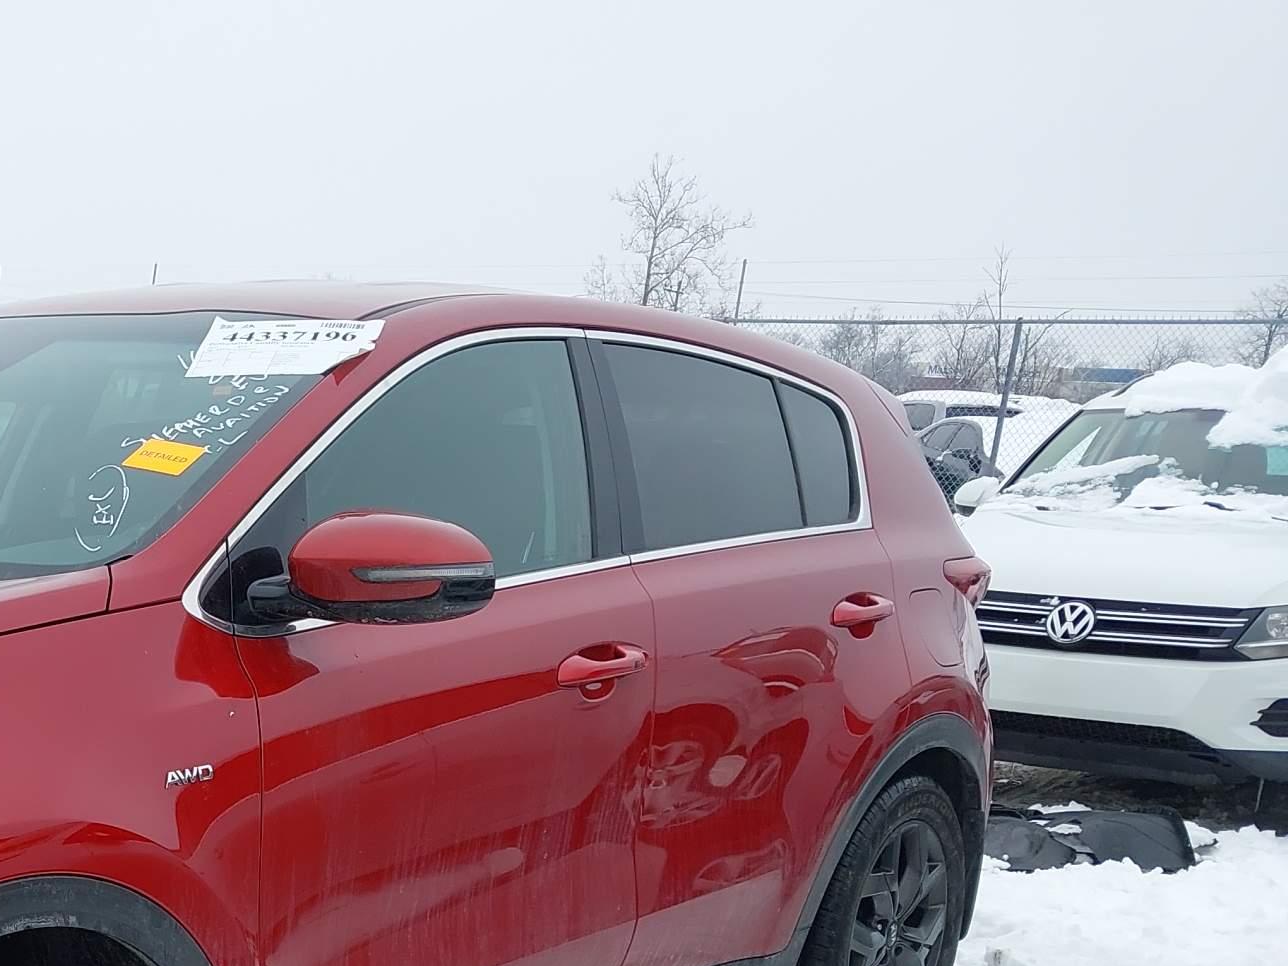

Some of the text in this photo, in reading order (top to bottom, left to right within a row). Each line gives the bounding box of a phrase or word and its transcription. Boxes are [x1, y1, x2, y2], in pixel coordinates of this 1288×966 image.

[222, 330, 358, 343] 44337196
[139, 449, 189, 464] DETAILED
[1049, 603, 1092, 641] VW
[164, 763, 214, 789] AWD
